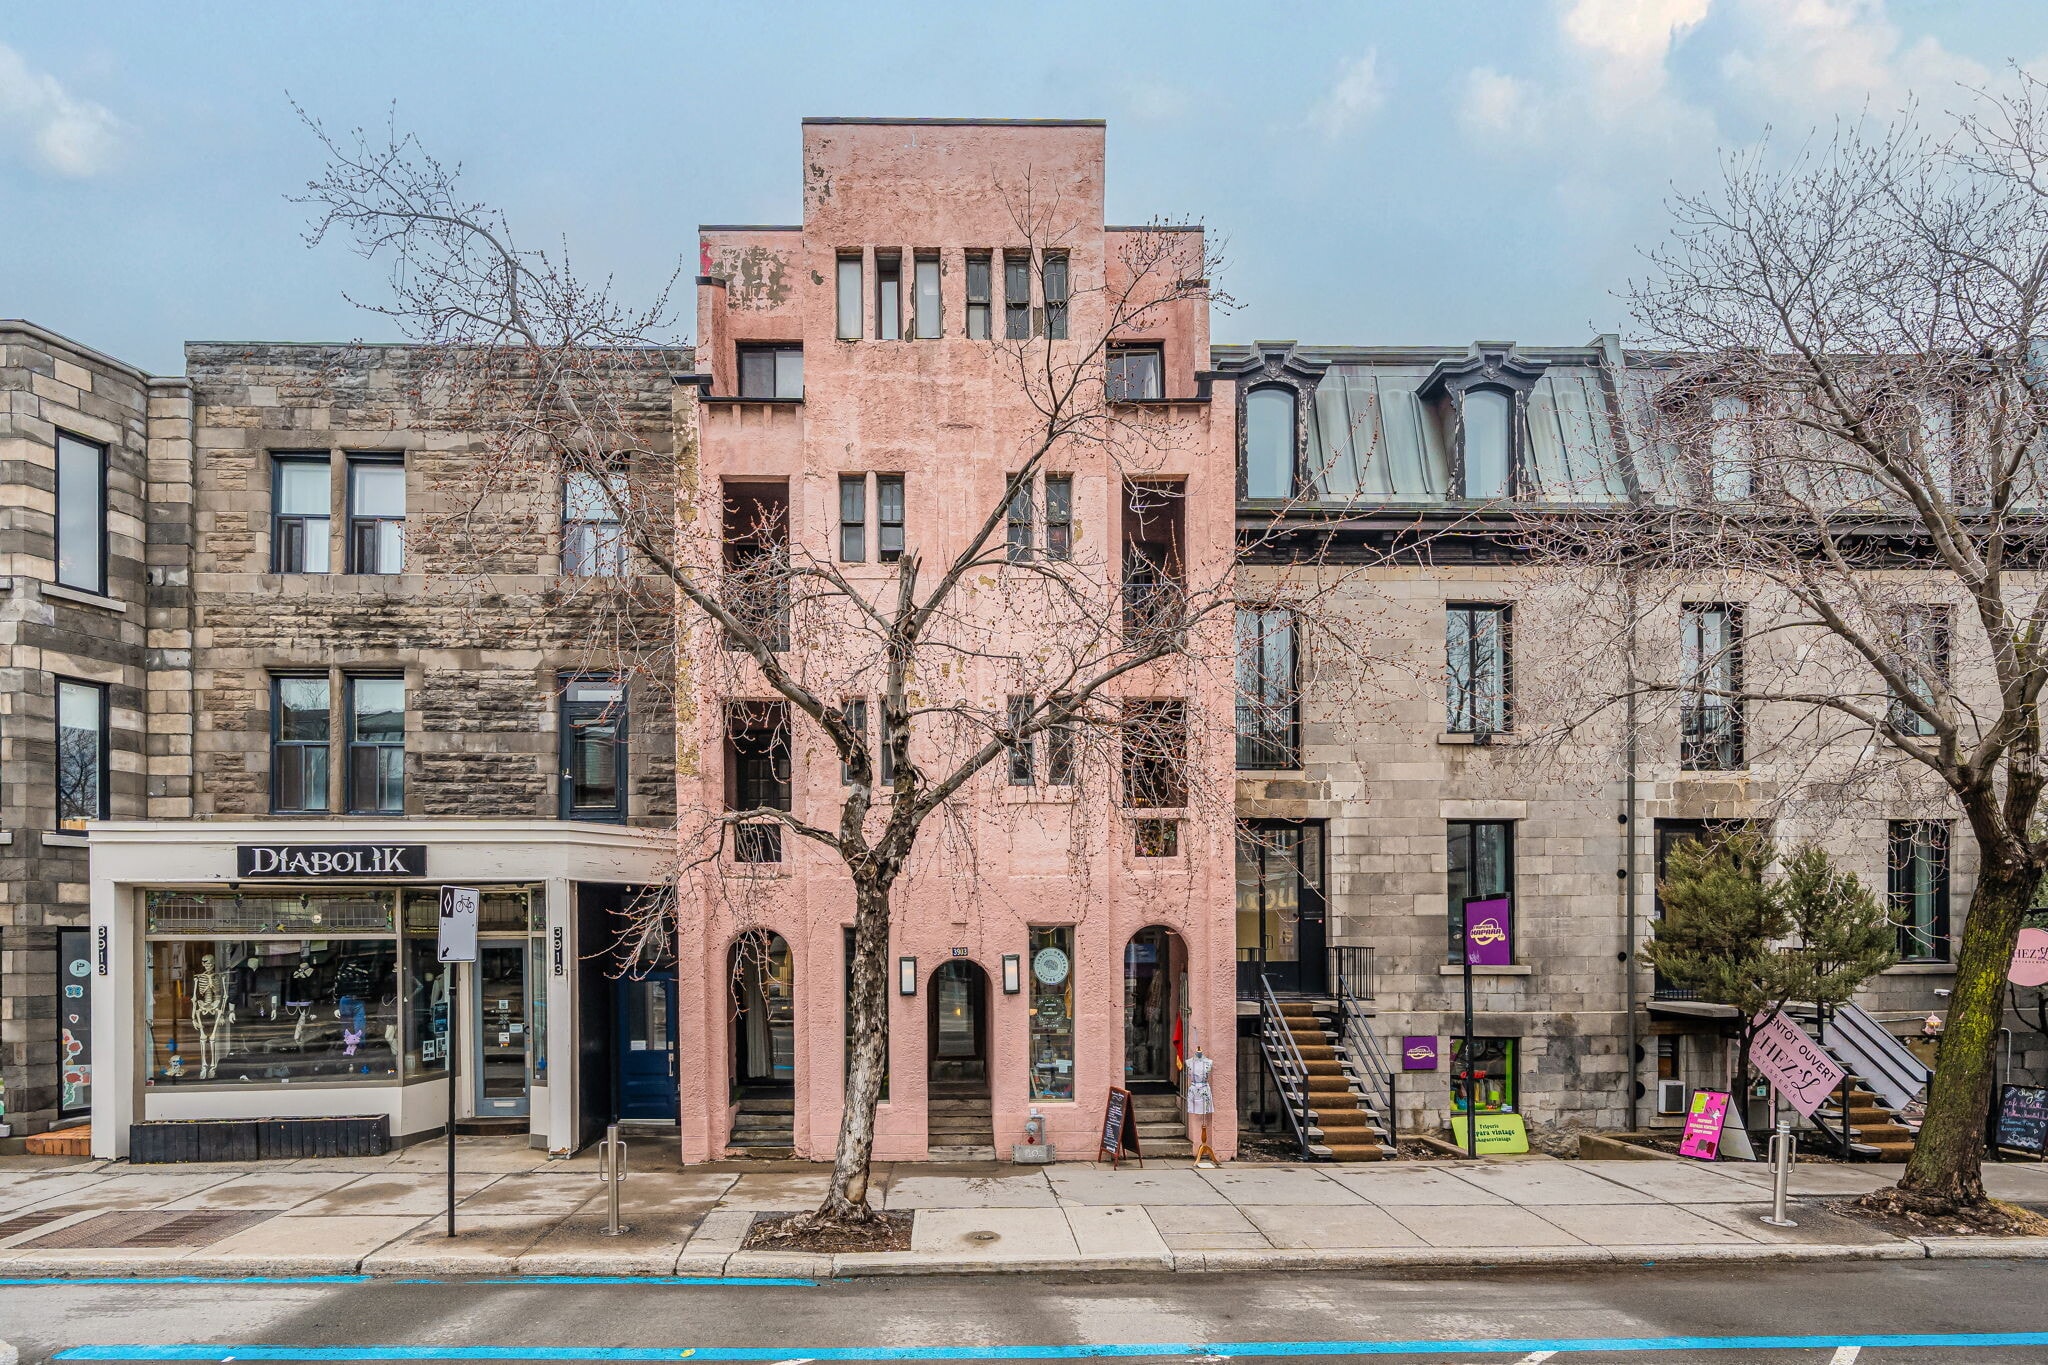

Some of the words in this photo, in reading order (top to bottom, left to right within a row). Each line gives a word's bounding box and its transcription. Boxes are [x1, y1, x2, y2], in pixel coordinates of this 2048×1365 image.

[249, 847, 411, 876] DIABOLIK
[554, 927, 562, 975] 3913
[1799, 1045, 1836, 1082] OUVERT
[1492, 1129, 1515, 1137] vintage
